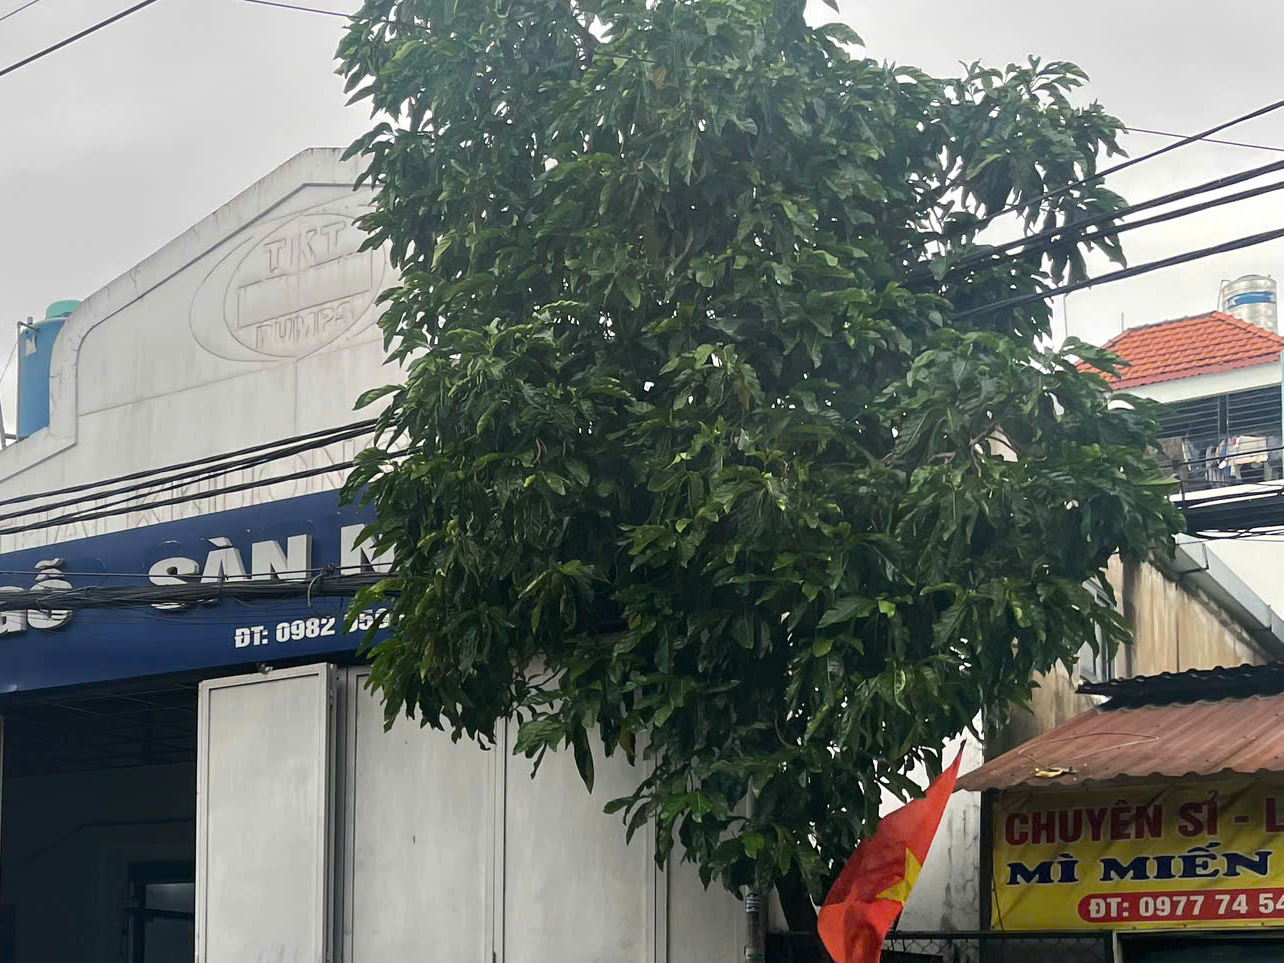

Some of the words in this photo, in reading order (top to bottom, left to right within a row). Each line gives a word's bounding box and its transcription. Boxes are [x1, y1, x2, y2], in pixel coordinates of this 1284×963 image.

[148, 535, 313, 609] SÀN
[234, 625, 268, 648] ĐT:
[276, 616, 336, 643] 0982
[1005, 799, 1163, 845] CHUYÊN
[1006, 853, 1079, 885] MÌ
[1100, 842, 1274, 880] MIẾN
[1089, 897, 1129, 918] ĐT:
[1139, 895, 1204, 917] 0977
[1215, 894, 1248, 915] 74
